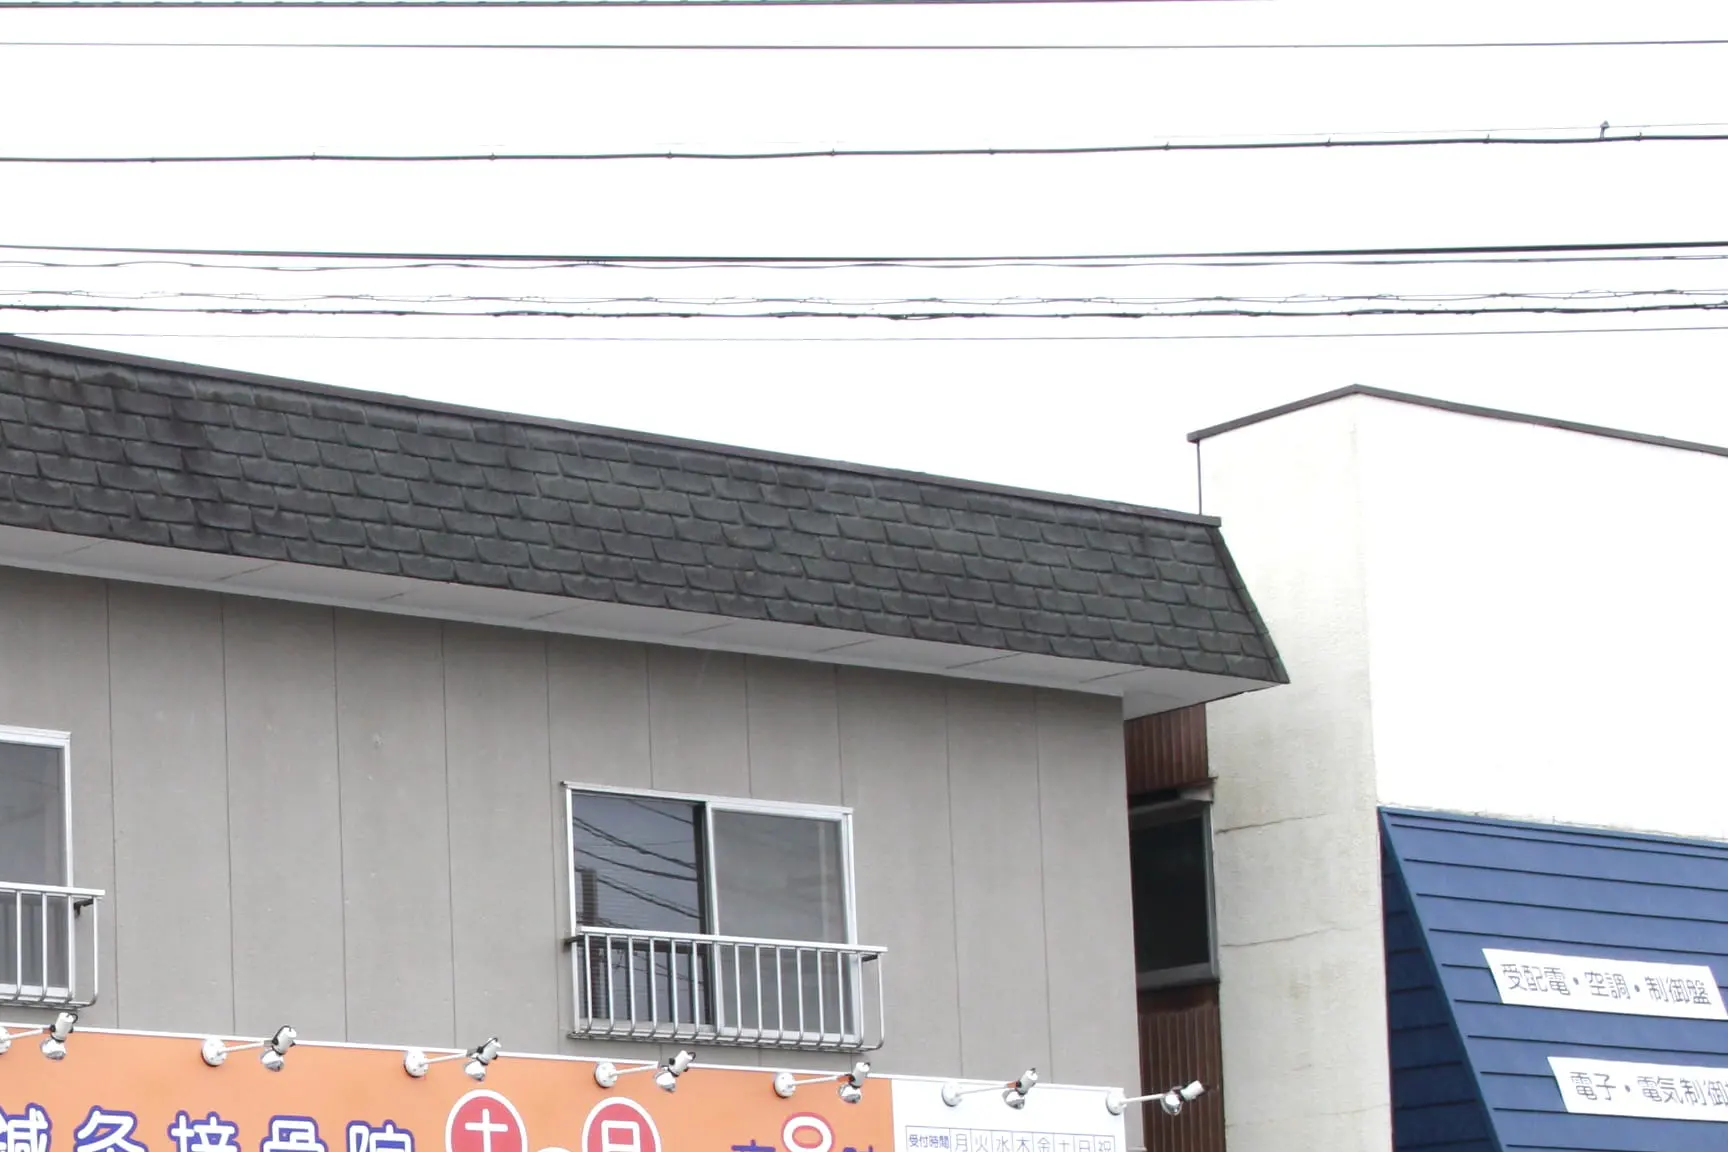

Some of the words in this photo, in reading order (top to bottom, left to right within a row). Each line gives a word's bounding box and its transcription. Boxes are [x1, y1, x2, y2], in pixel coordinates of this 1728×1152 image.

[908, 1133, 951, 1151] 受付時間
[954, 1132, 969, 1152] 月
